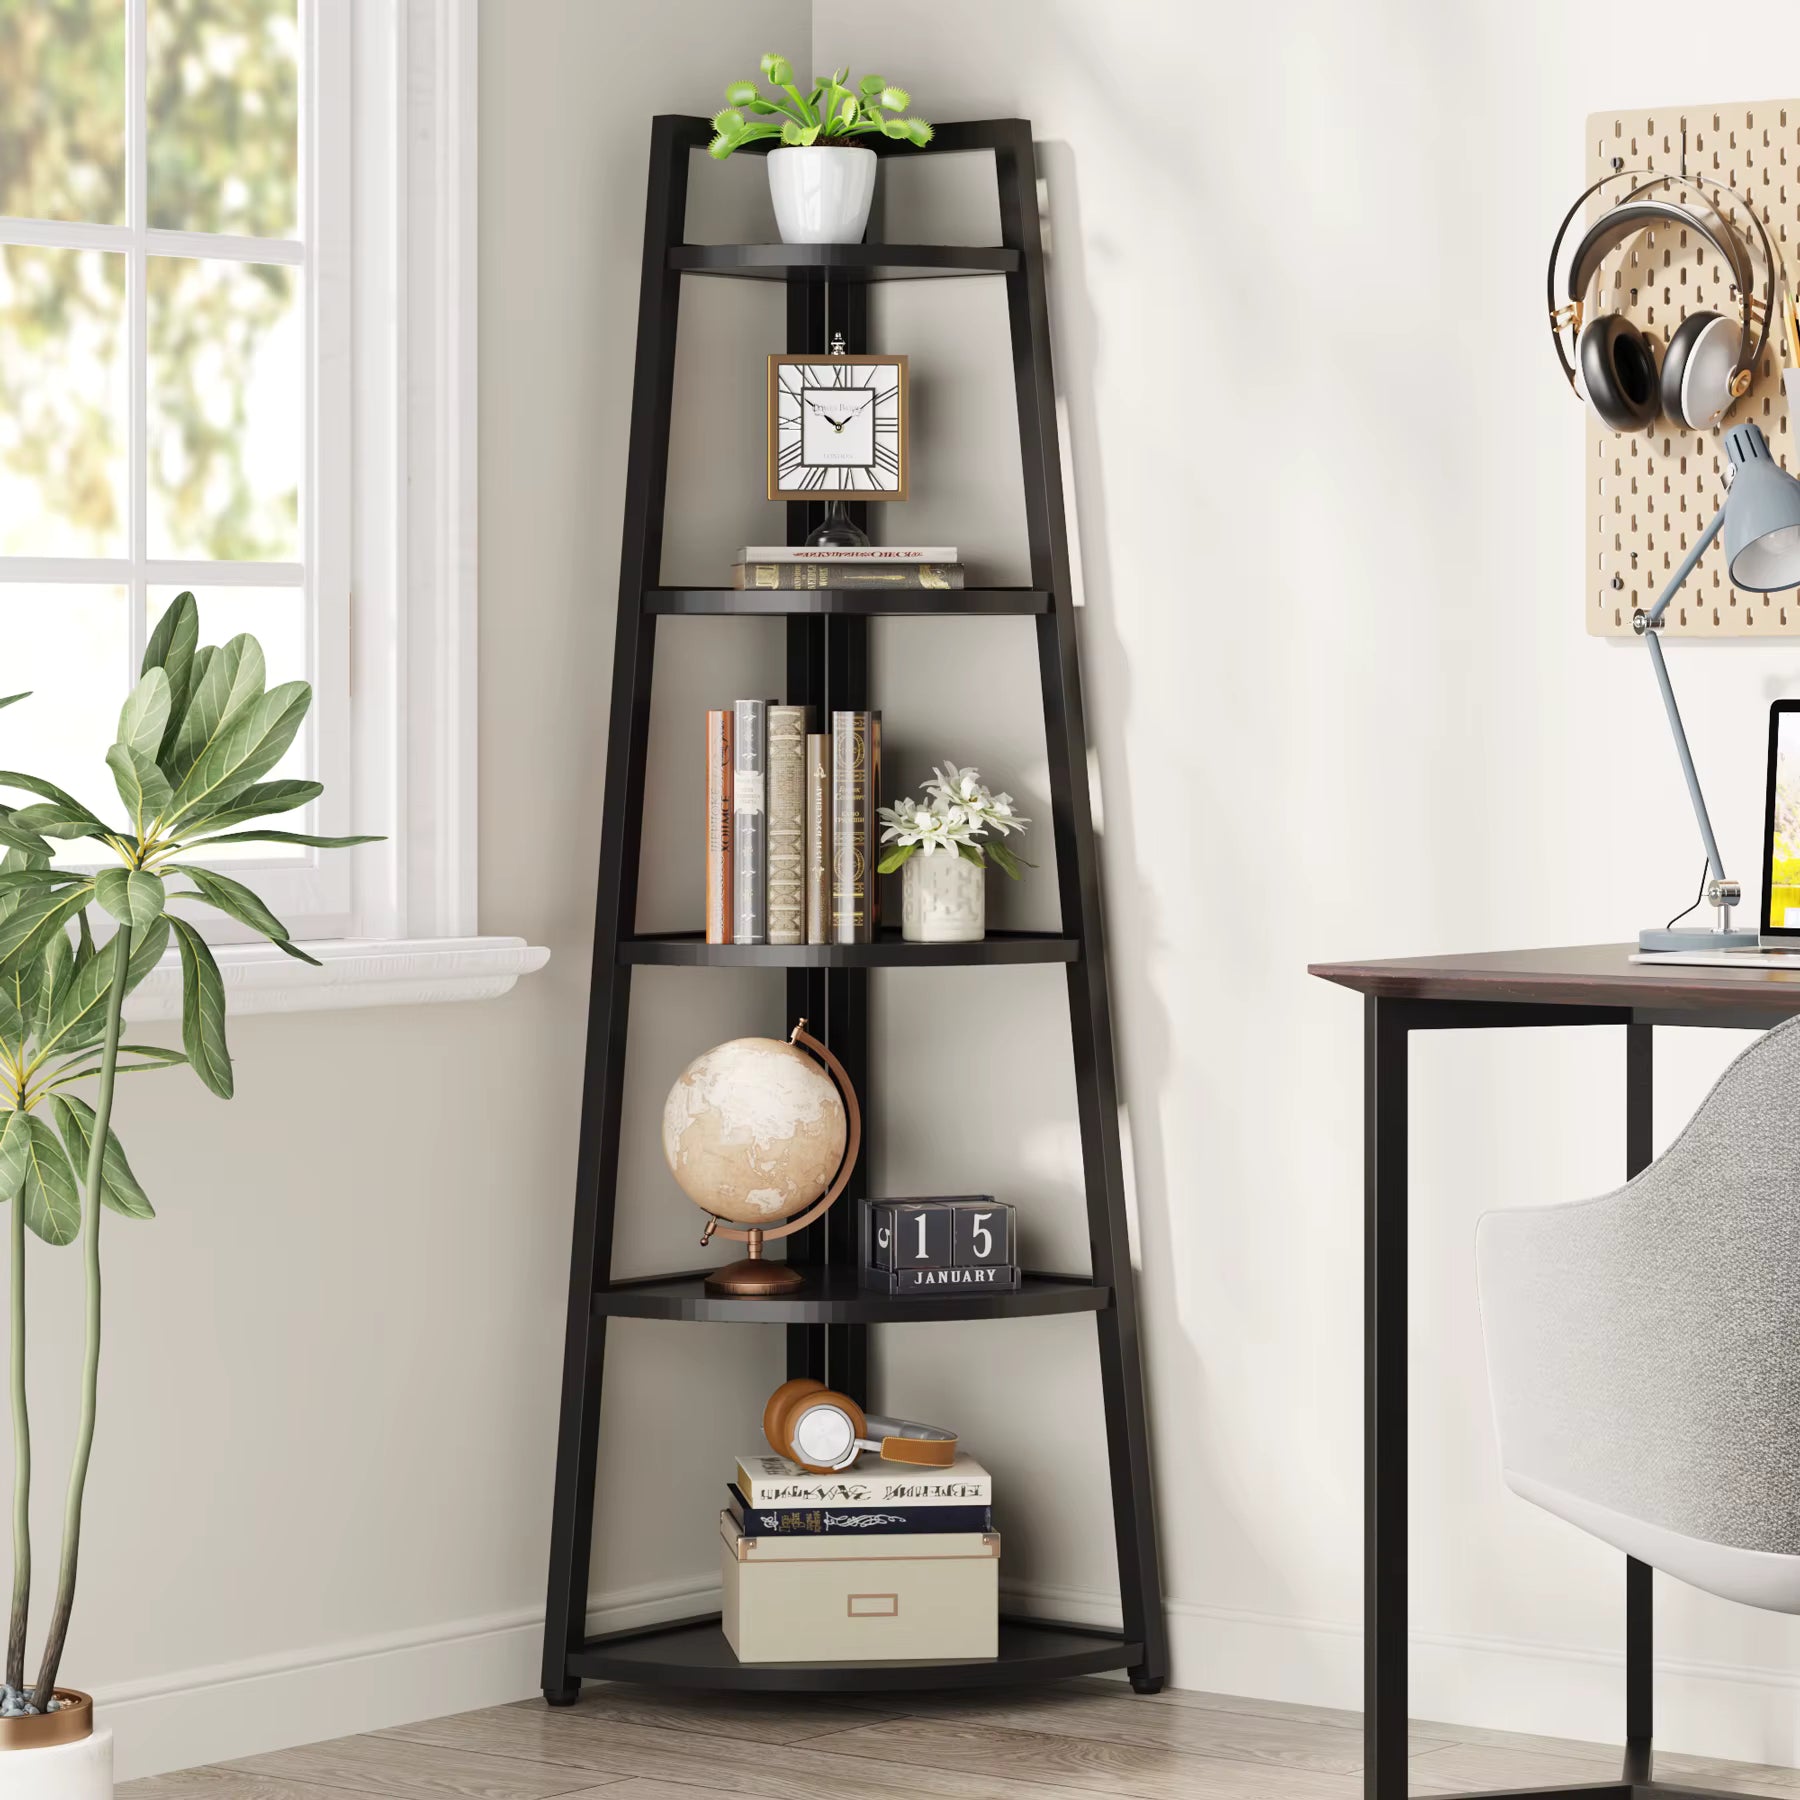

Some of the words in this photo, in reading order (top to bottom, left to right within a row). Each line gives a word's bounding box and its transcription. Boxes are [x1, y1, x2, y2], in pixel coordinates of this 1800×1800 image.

[833, 364, 853, 388] XII
[875, 417, 898, 432] III
[914, 1269, 997, 1285] JANUARY
